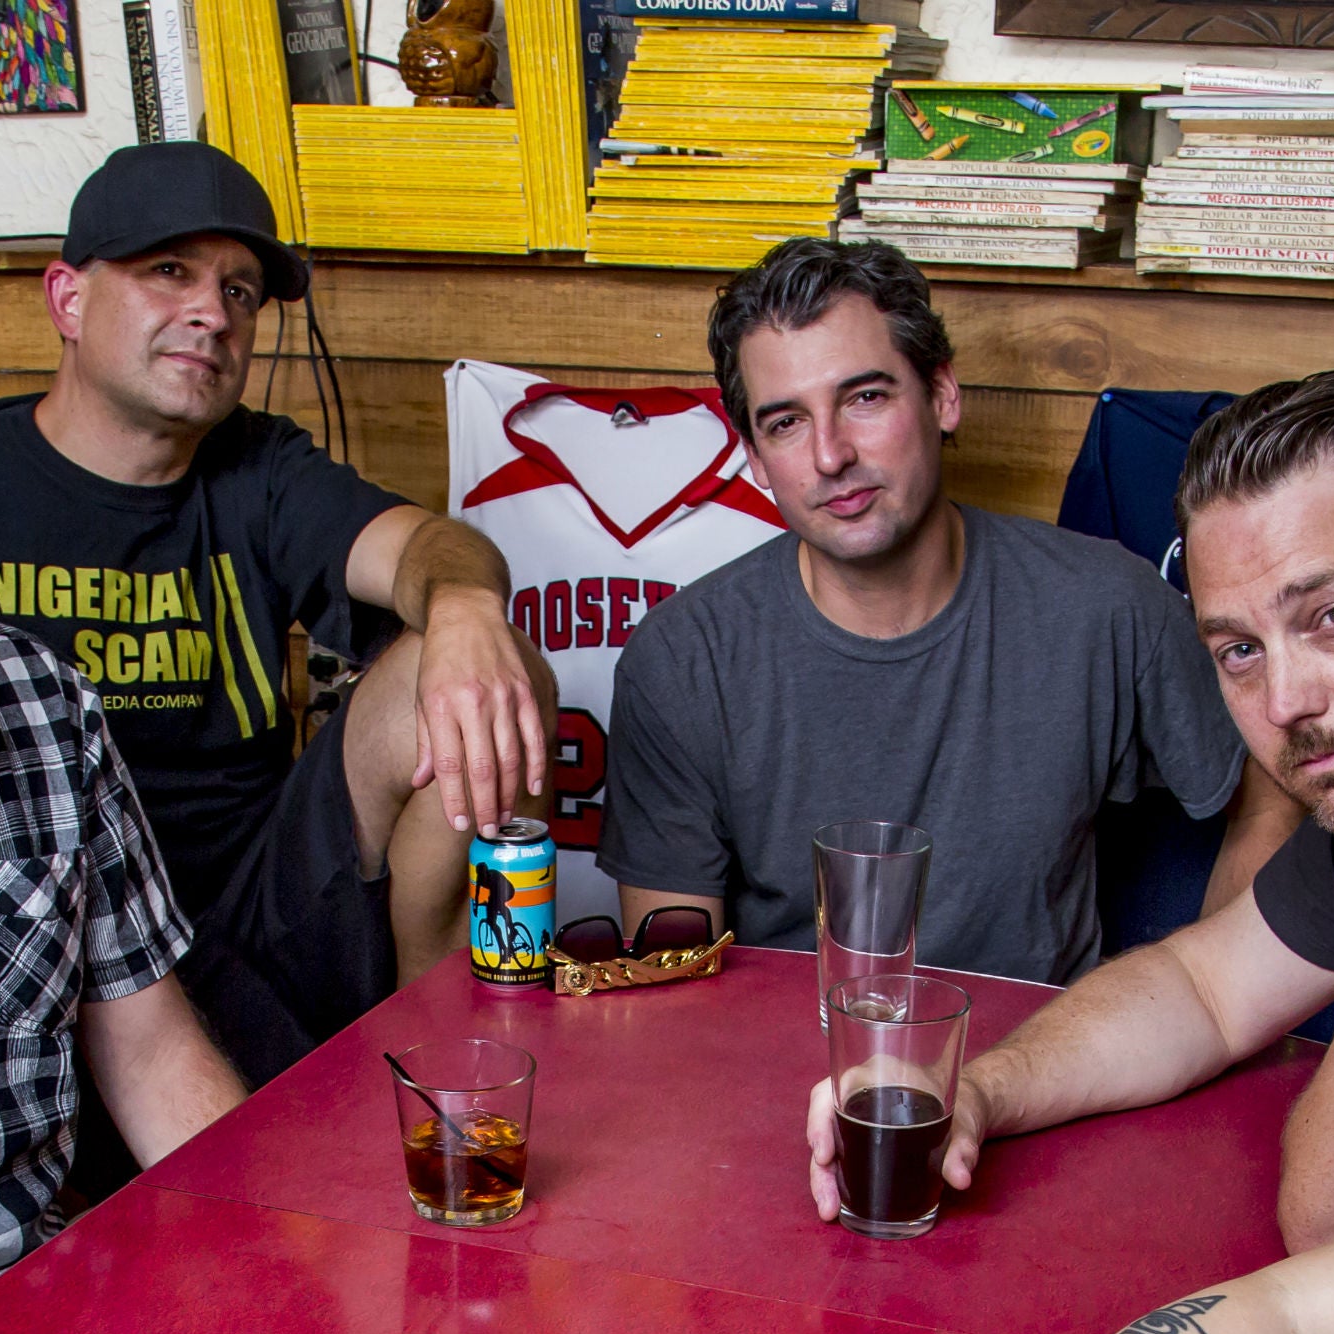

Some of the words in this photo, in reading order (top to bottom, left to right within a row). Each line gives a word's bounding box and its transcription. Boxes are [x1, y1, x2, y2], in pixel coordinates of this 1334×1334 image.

[734, 0, 786, 12] TODAY
[165, 10, 179, 39] ONE
[296, 11, 335, 29] NATIONAL
[136, 16, 151, 60] FUNK
[287, 26, 346, 54] GEOGRAPHIC
[141, 63, 153, 76] &
[169, 46, 185, 105] VOLUME
[1241, 111, 1294, 120] POPULAR
[1256, 136, 1310, 146] POPULAR
[1250, 149, 1299, 158] MECHANIX
[950, 163, 1000, 173] POPULAR
[1006, 165, 1067, 176] MECHANICS
[935, 176, 985, 186] POPULAR
[989, 179, 1053, 189] MECHANICS
[1216, 173, 1267, 183] POPULAR
[924, 188, 974, 198] POPULAR
[980, 190, 1045, 200] MECHANICS
[1210, 183, 1261, 192] POPULAR
[1206, 194, 1267, 205] MECHANIX
[914, 200, 972, 211] MECHANIX
[976, 201, 1042, 214] ILLUSTRATED
[1201, 210, 1252, 221] POPULAR
[1259, 212, 1326, 223] MECHANICS
[1199, 221, 1251, 231] POPULAR
[1258, 223, 1325, 233] MECHANICS
[906, 237, 956, 246] POPULAR
[1209, 235, 1261, 246] POPULAR
[1268, 237, 1334, 248] MECHANICS
[953, 251, 1015, 261] MECHANICS
[1207, 245, 1272, 258] POPULAR
[1211, 260, 1263, 271] POPULAR
[74, 629, 213, 684] SCAM
